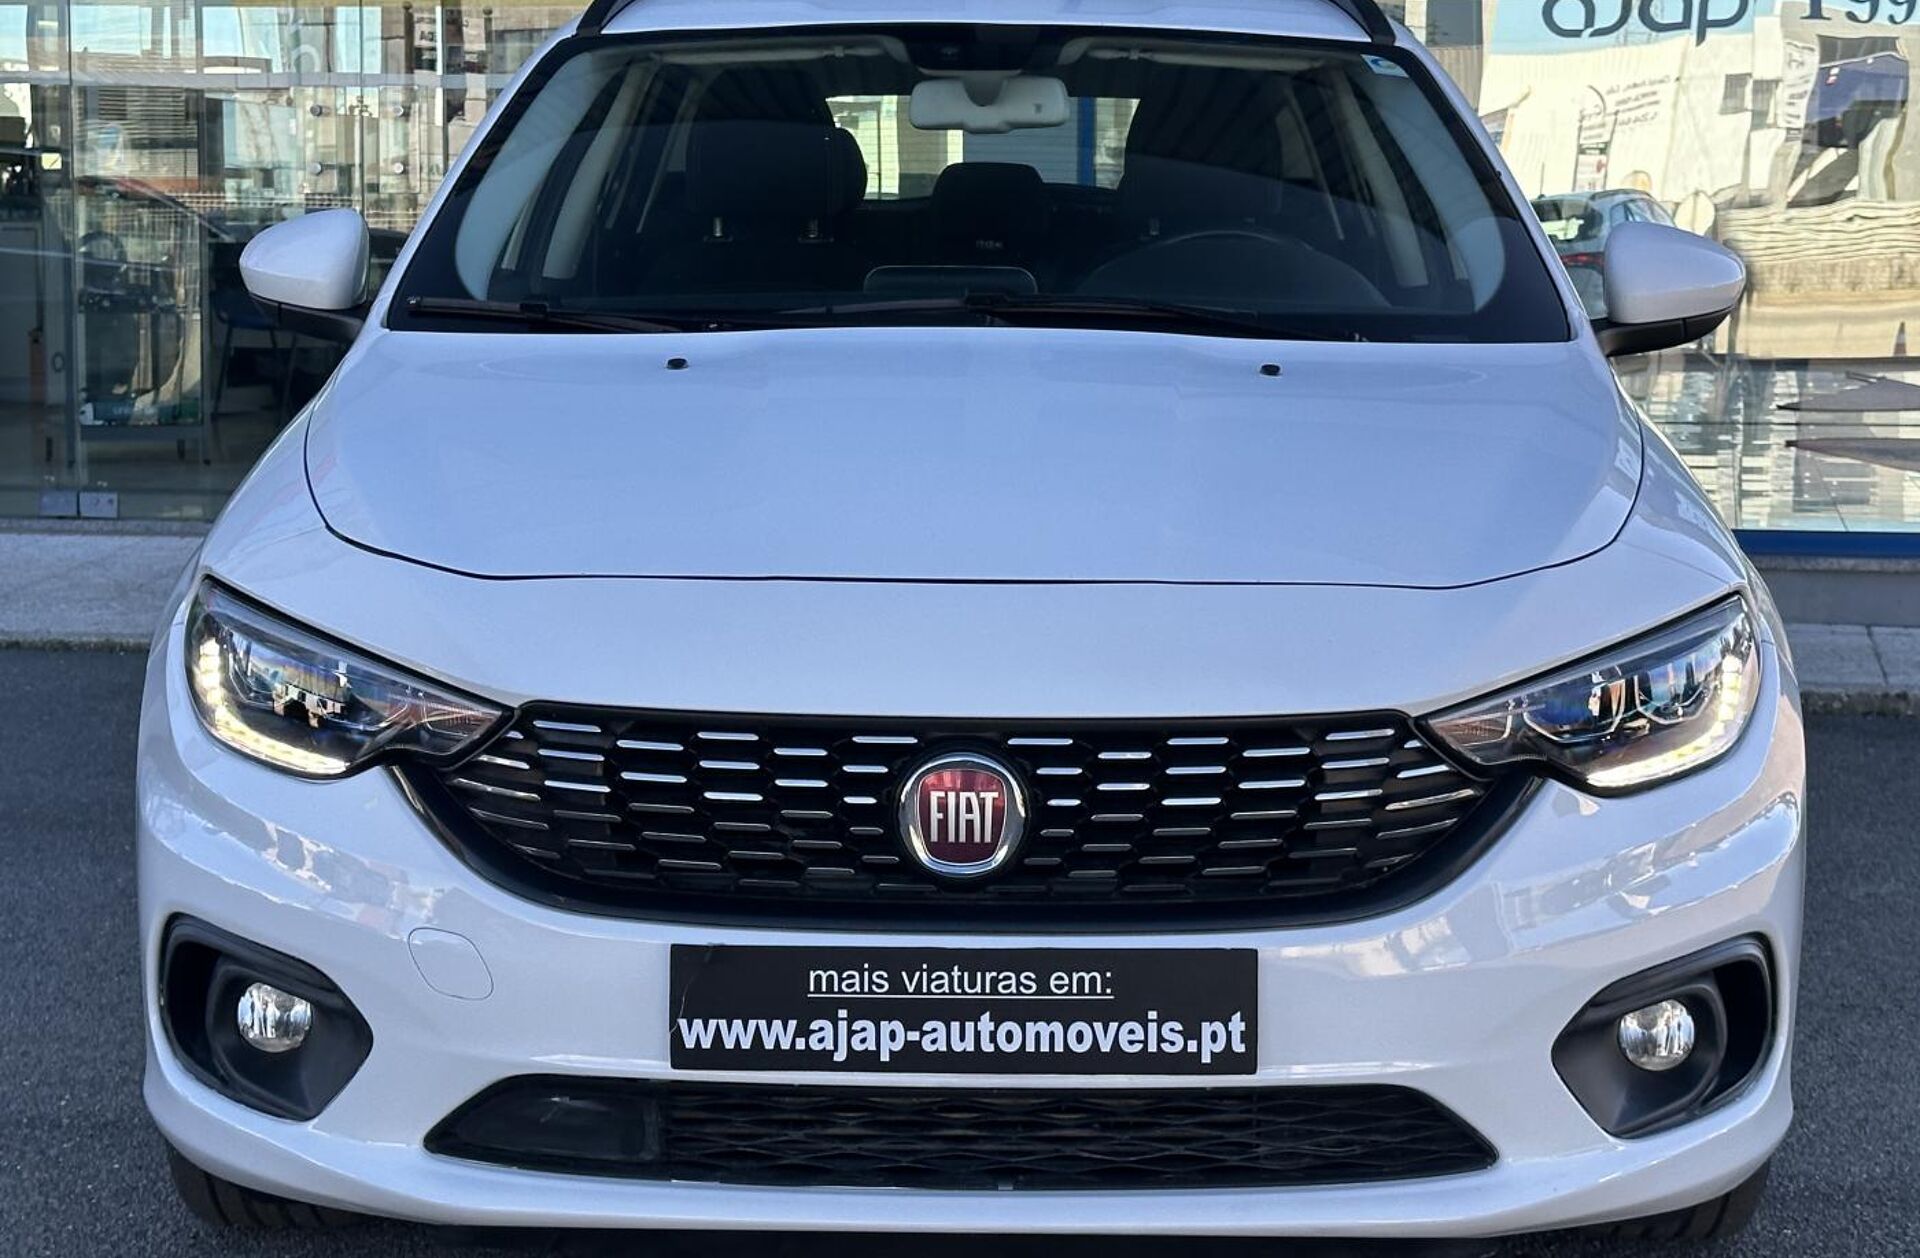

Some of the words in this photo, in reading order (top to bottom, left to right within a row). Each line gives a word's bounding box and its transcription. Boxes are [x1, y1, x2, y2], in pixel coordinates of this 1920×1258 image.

[930, 790, 999, 843] FIAT
[808, 963, 889, 993] mais
[901, 964, 1037, 994] viaturas
[1049, 969, 1113, 994] em:
[678, 1009, 1246, 1063] www.ajap-automoveis.pt
